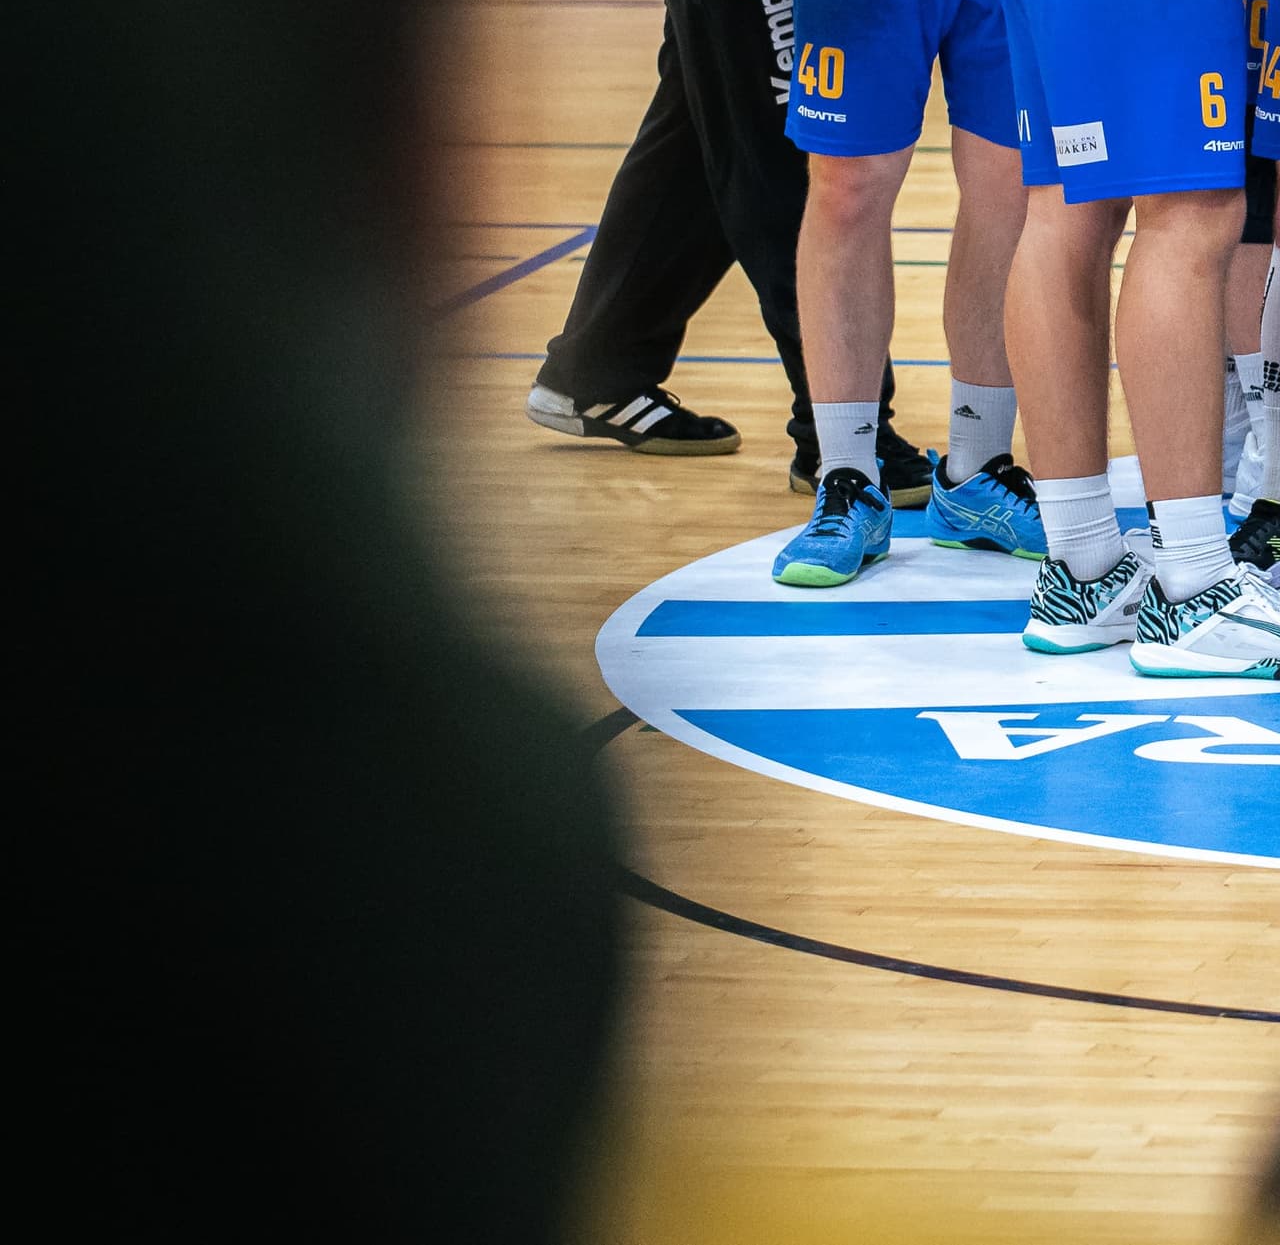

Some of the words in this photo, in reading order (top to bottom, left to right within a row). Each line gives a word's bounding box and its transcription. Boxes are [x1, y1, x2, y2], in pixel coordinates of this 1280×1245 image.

[797, 42, 846, 100] 40
[1199, 72, 1227, 128] 6
[1056, 141, 1098, 155] UAKEN
